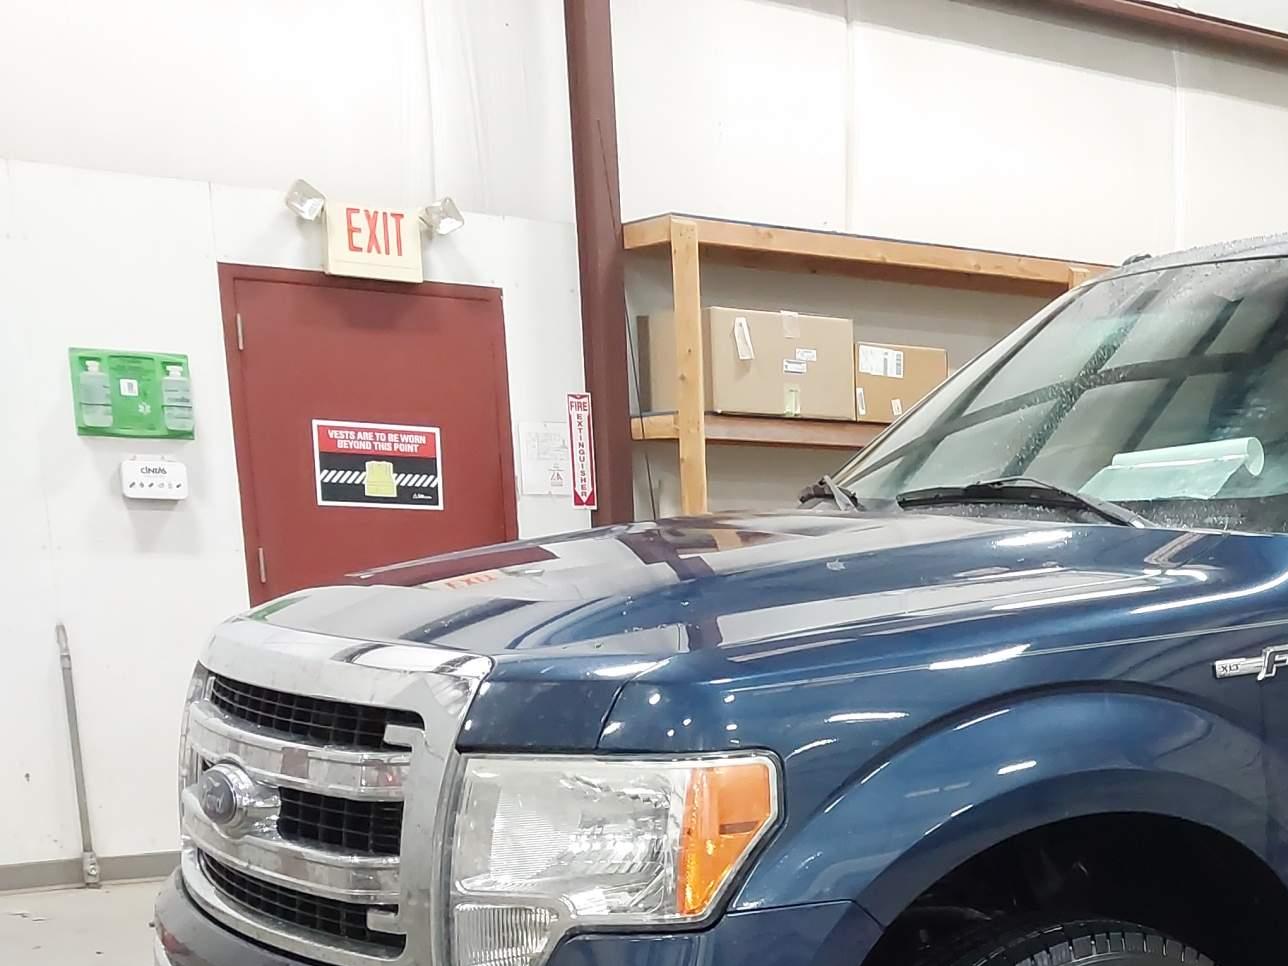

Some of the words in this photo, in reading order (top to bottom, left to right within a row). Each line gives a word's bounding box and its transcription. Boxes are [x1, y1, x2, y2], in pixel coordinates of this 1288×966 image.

[345, 207, 404, 257] EXIT
[569, 400, 588, 412] FIRE
[327, 429, 356, 440] VESTS
[357, 431, 374, 441] ARE
[375, 432, 387, 442] TO
[388, 433, 399, 443] BE
[400, 434, 426, 444] WORN
[337, 439, 372, 451] BEYOND
[373, 441, 392, 452] THIS
[393, 443, 420, 453] POINT
[576, 413, 588, 498] EXTINGUISHER
[1219, 663, 1240, 673] XLT
